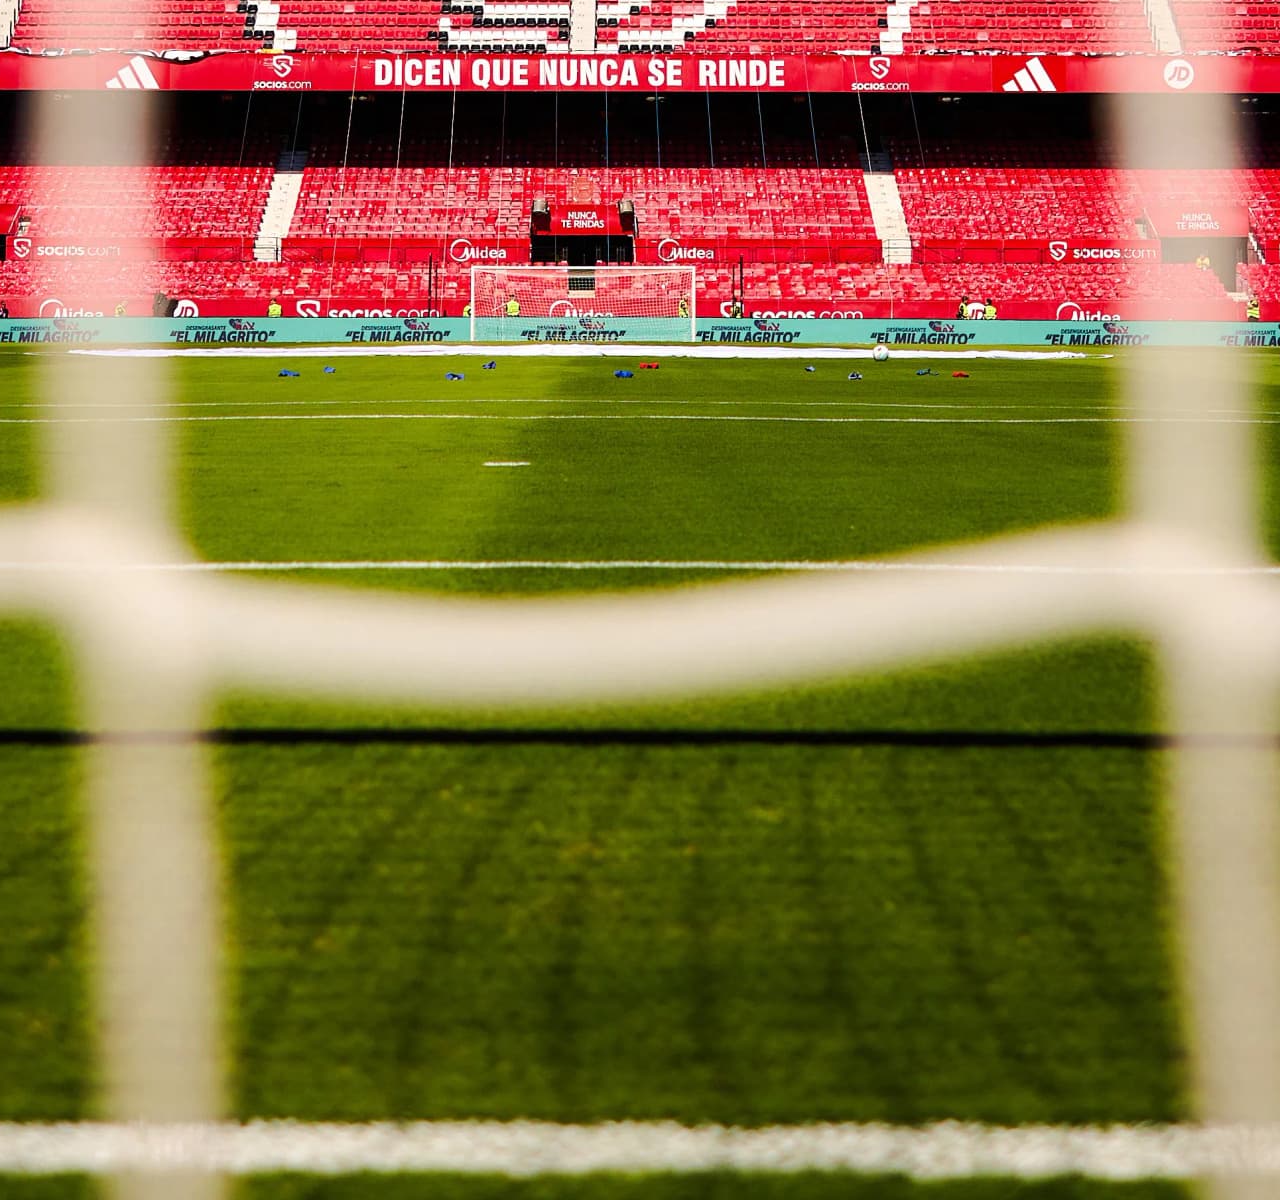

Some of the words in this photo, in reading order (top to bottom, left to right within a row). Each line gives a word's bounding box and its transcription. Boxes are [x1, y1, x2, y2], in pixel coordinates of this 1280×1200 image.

[374, 58, 461, 87] DICEN
[471, 58, 529, 90] QUE
[539, 58, 639, 87] NUNCA
[647, 58, 683, 87] SE
[698, 58, 785, 88] RINDE
[254, 81, 312, 89] socios.com
[851, 82, 910, 91] socios.com
[567, 211, 598, 220] NUNCA
[1182, 213, 1211, 222] NUNCA
[561, 219, 572, 228] TE
[1176, 221, 1187, 230] TE
[457, 243, 507, 260] Midea
[664, 243, 714, 260] Midea
